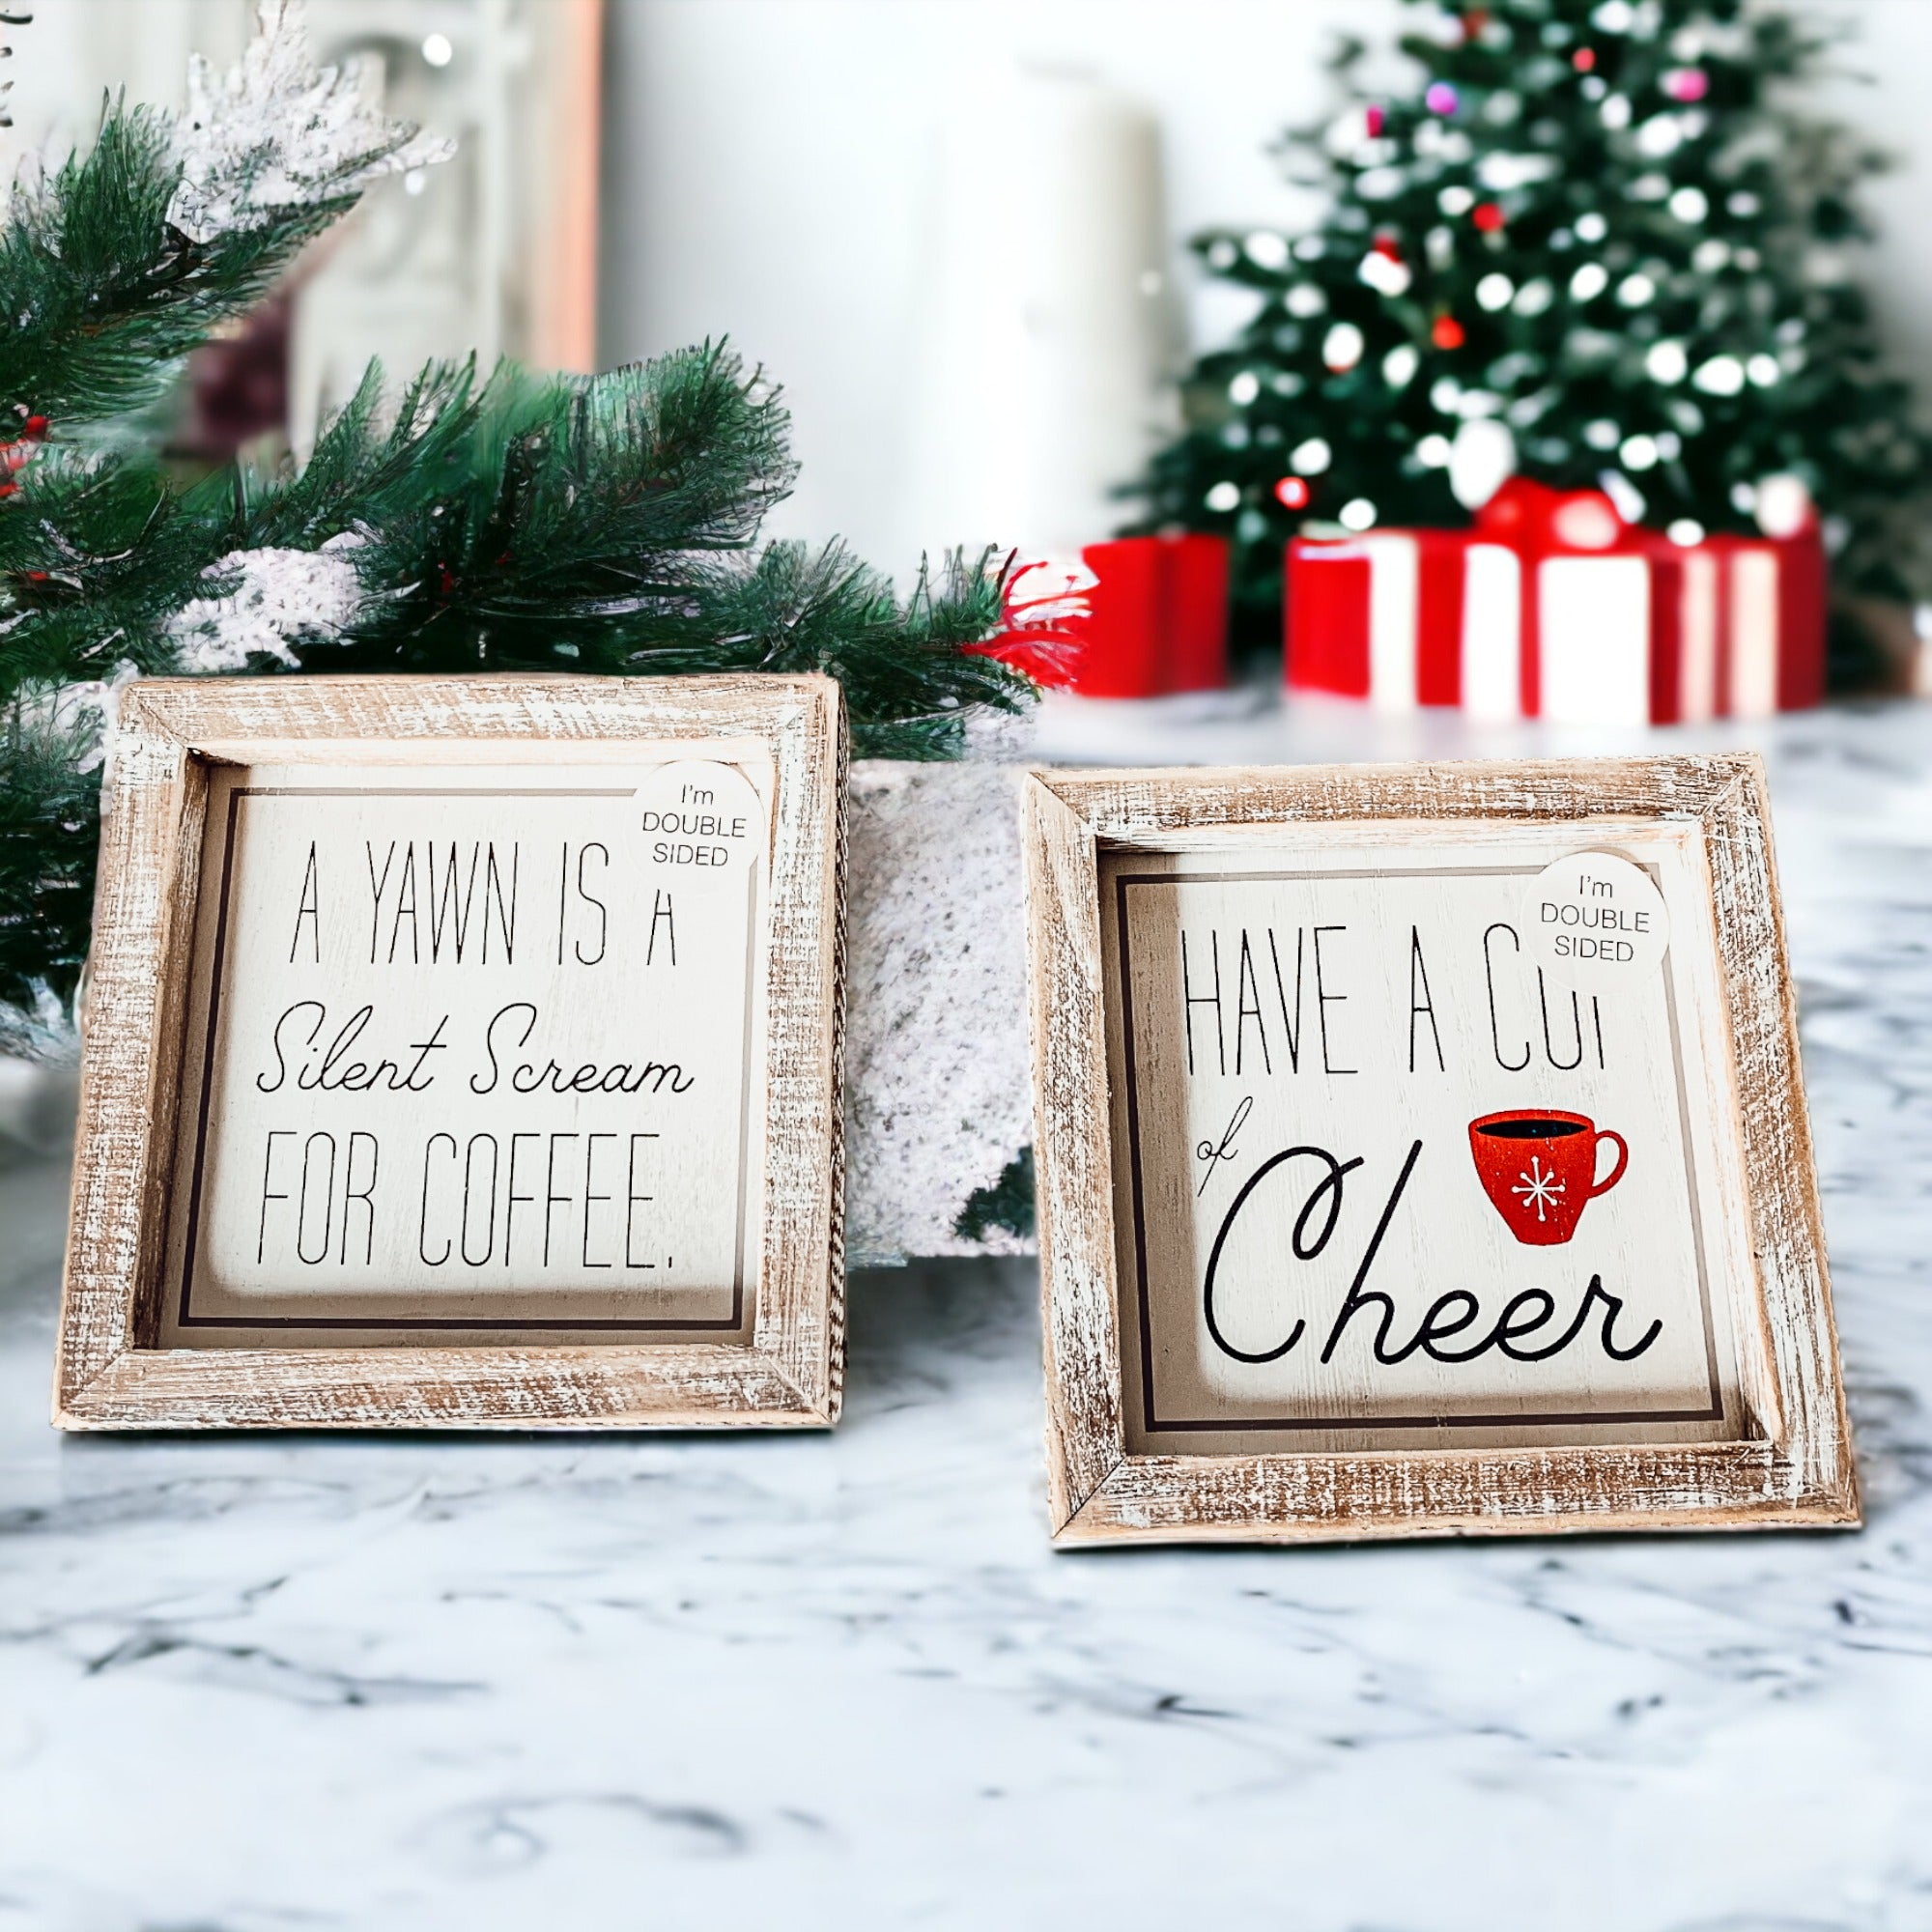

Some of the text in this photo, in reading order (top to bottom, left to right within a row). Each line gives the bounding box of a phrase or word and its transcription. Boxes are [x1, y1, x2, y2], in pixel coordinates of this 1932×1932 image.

[641, 811, 748, 838] DOUBLE
[681, 783, 715, 807] I'm
[652, 842, 729, 867] SIDED
[289, 840, 676, 966] A YAWN IS A
[1540, 902, 1651, 933] DOUBLE
[1578, 874, 1614, 900] I'm
[1553, 935, 1634, 963] SIDED
[1180, 925, 1359, 1075] HAVE
[1409, 924, 1446, 1073] A
[256, 1001, 696, 1094] Silent Scream
[1196, 1095, 1254, 1198] of
[257, 1131, 673, 1269] FOR COFFEE.
[1203, 1139, 1664, 1365] Cheer
